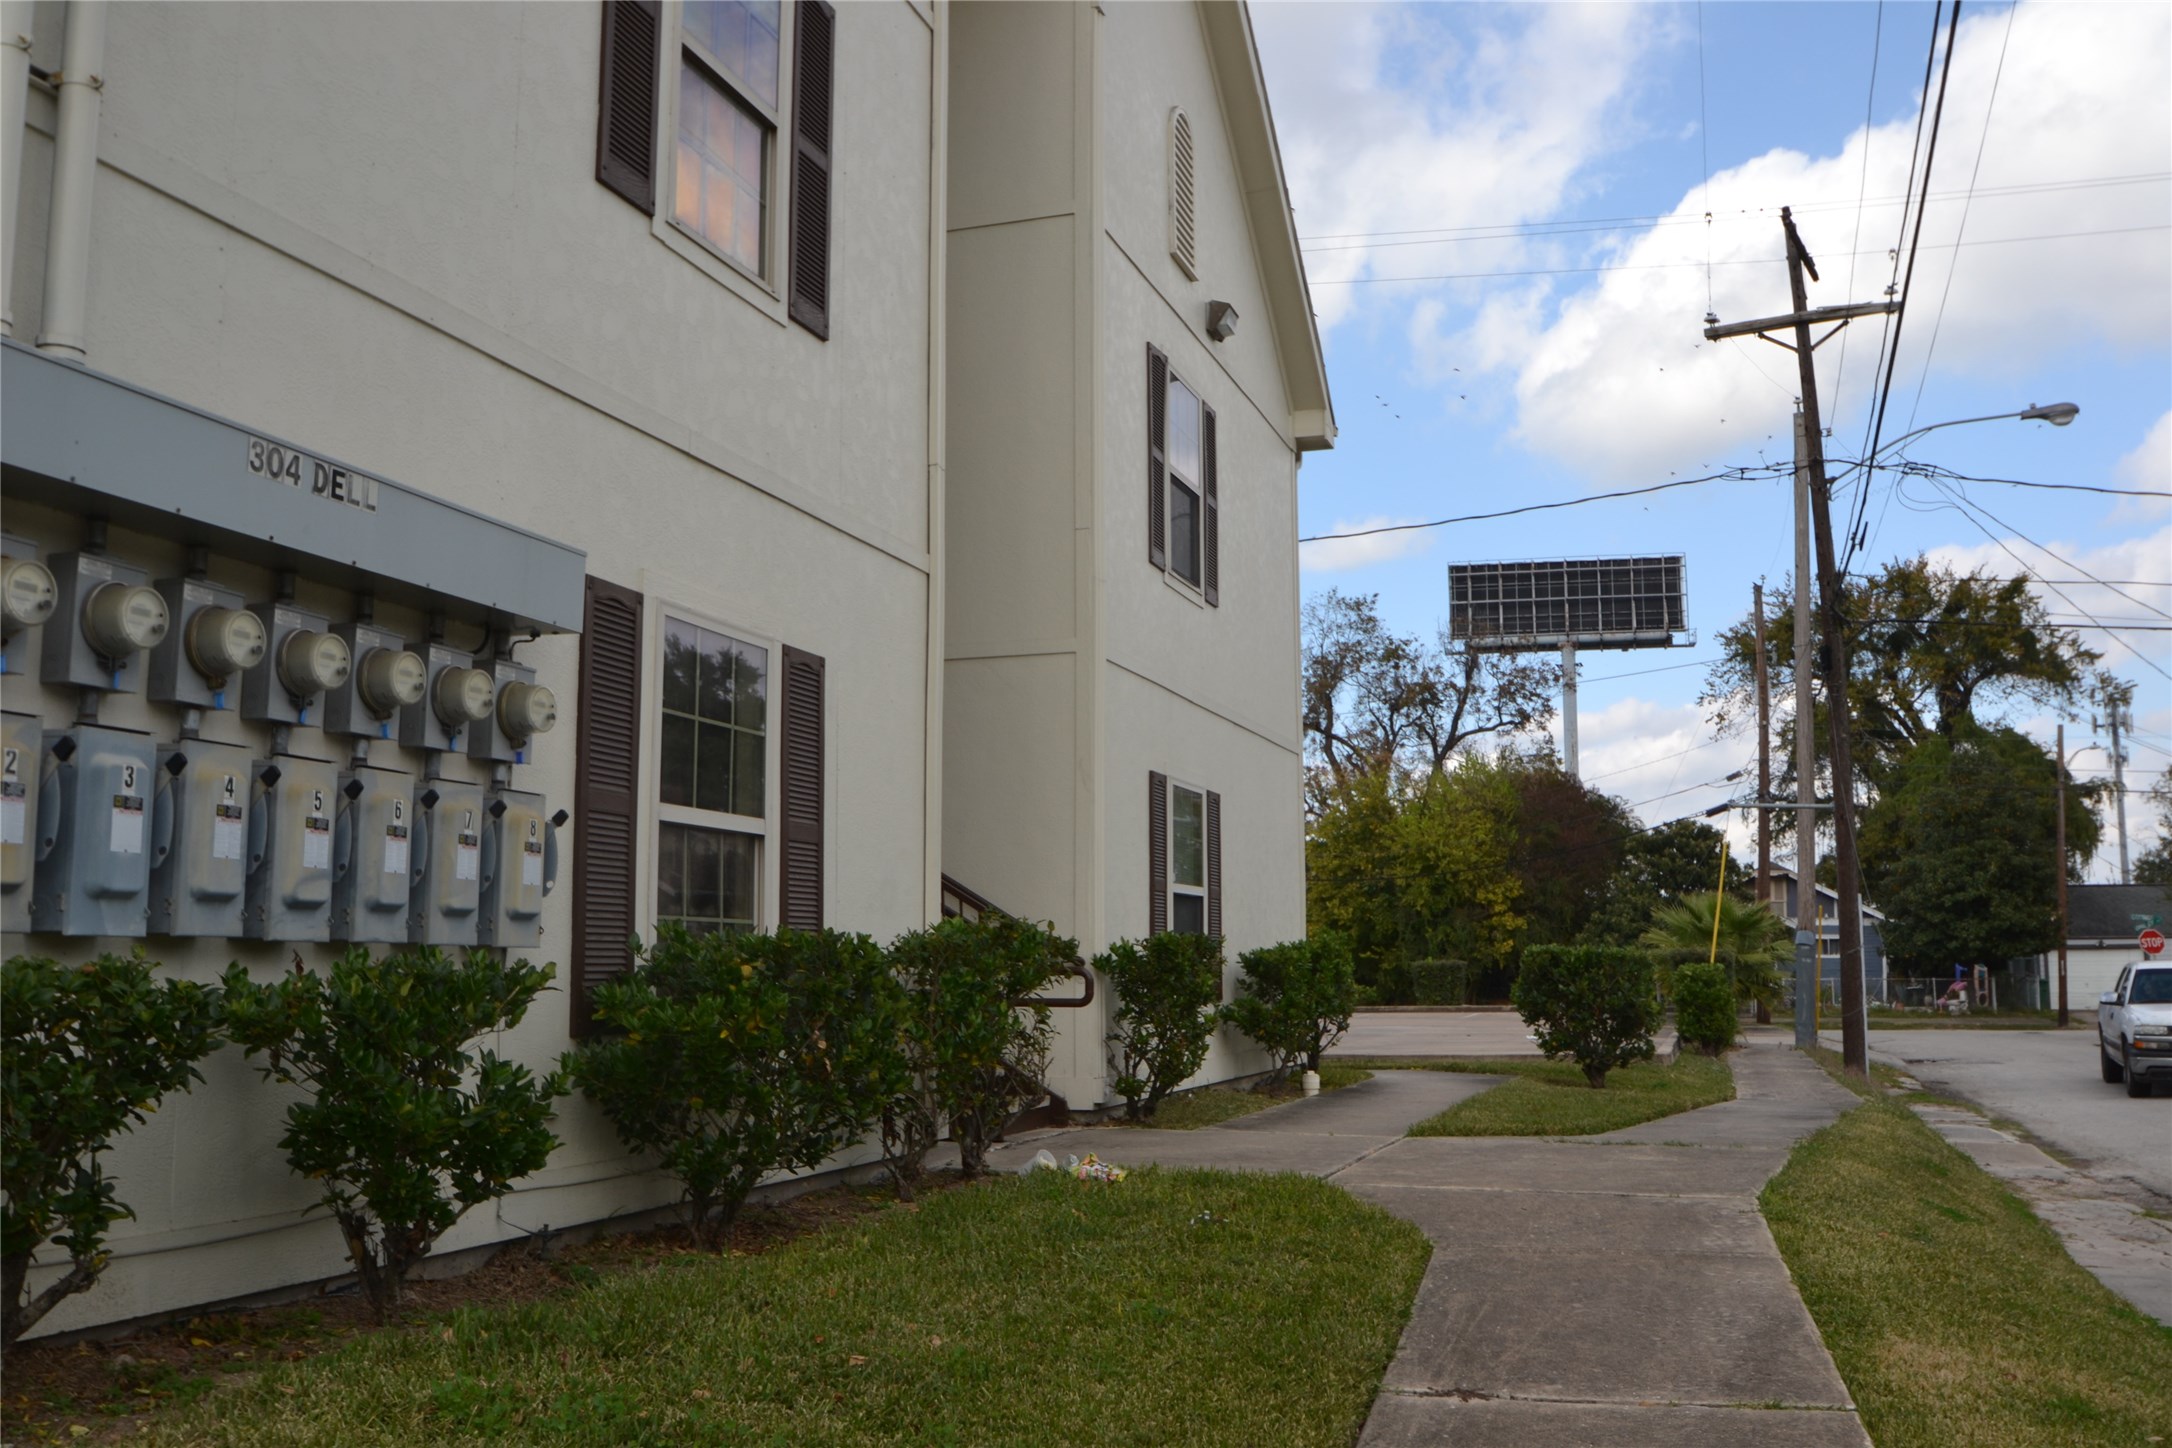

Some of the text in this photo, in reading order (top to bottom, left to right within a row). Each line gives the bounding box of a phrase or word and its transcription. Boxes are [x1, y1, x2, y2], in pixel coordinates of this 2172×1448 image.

[249, 440, 376, 512] 304 DELL
[5, 750, 17, 775] 2
[124, 765, 135, 788] 3
[225, 777, 235, 798] 4
[314, 791, 322, 811] 5
[394, 801, 403, 820] 6
[464, 811, 473, 830] 7
[530, 820, 537, 837] 8
[2141, 937, 2163, 948] STOP
